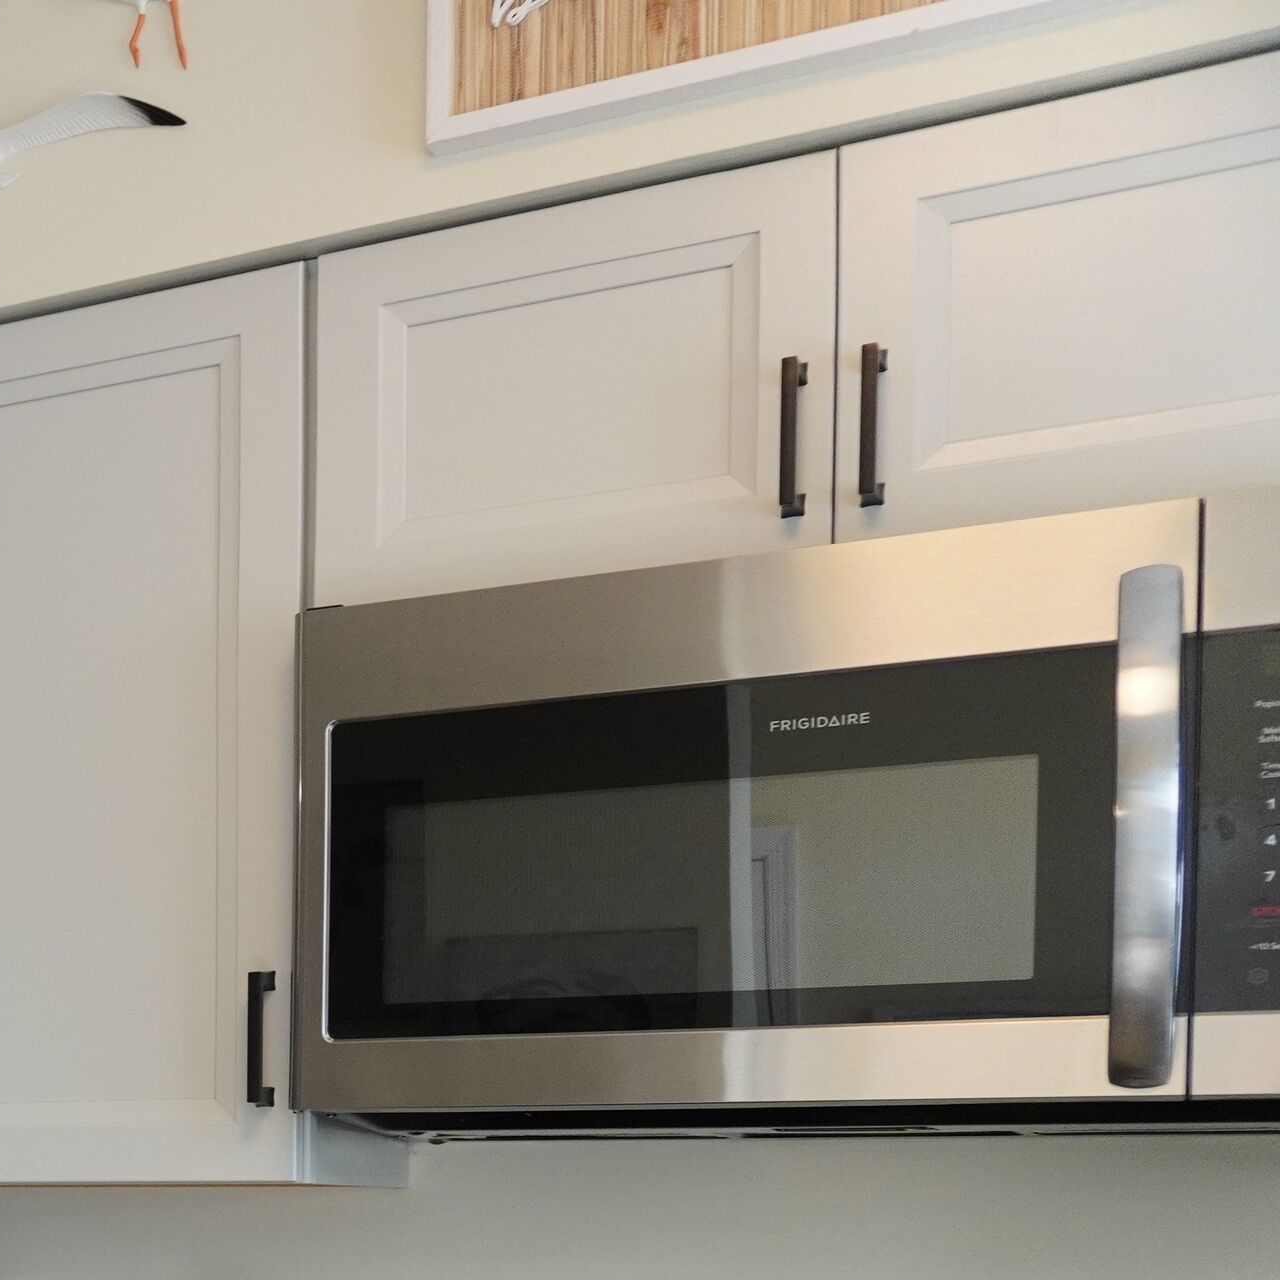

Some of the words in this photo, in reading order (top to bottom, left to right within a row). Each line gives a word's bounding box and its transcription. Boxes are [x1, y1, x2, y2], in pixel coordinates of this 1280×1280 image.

[769, 712, 871, 732] FRIGIDAIRE
[1265, 798, 1276, 810] 1
[1263, 834, 1278, 846] 4
[1264, 870, 1276, 882] 7
